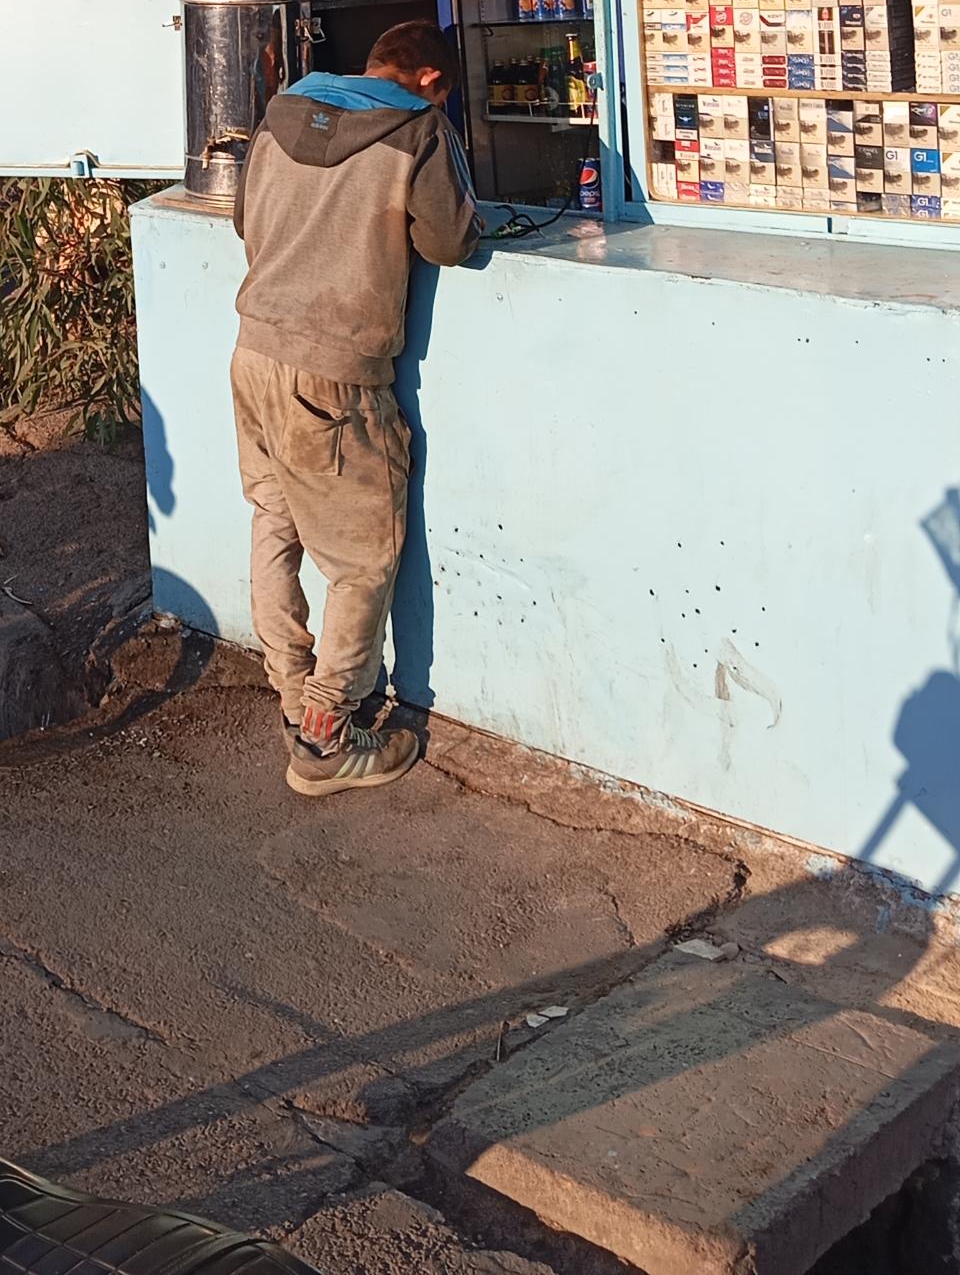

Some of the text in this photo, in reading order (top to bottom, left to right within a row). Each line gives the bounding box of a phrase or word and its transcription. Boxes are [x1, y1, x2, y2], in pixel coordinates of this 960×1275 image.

[885, 150, 898, 161] G1
[913, 151, 927, 162] G1
[917, 197, 929, 206] G1
